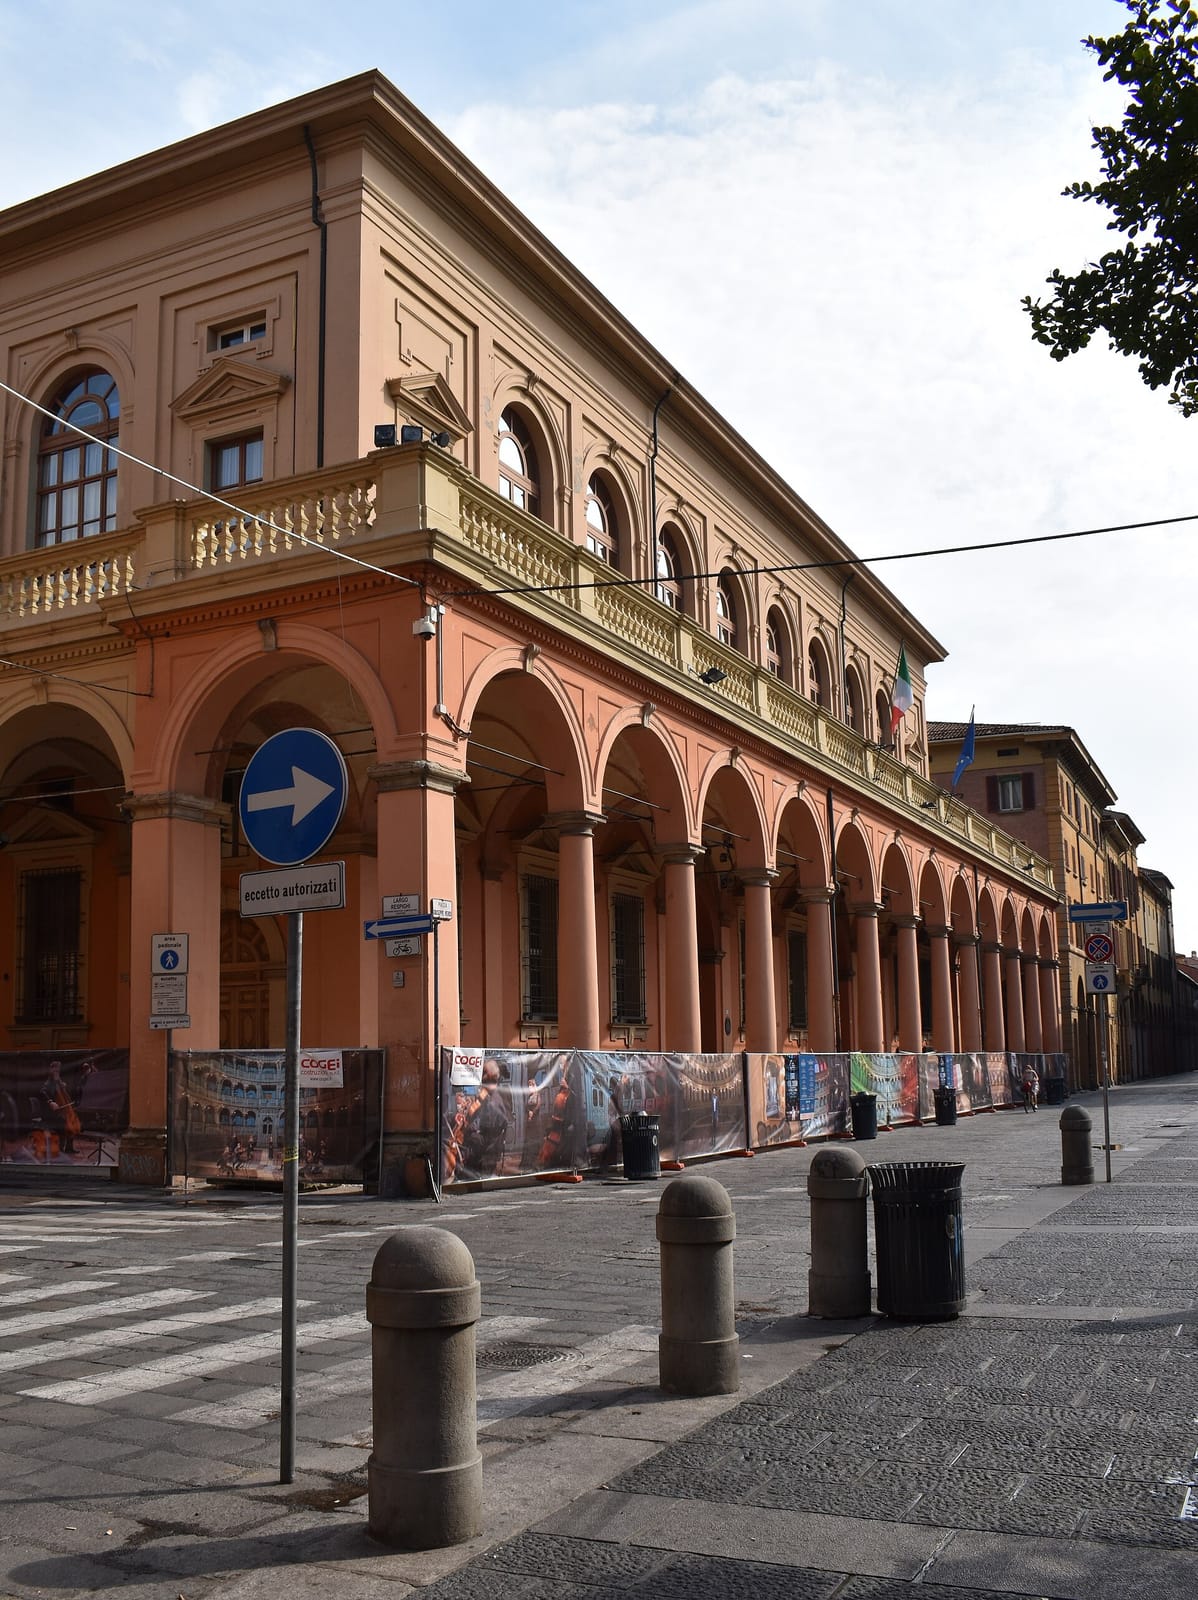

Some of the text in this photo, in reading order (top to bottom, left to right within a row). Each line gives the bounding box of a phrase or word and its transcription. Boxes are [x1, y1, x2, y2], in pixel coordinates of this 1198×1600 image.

[245, 878, 337, 902] eccetto autorizzati
[301, 1058, 340, 1071] COGEi
